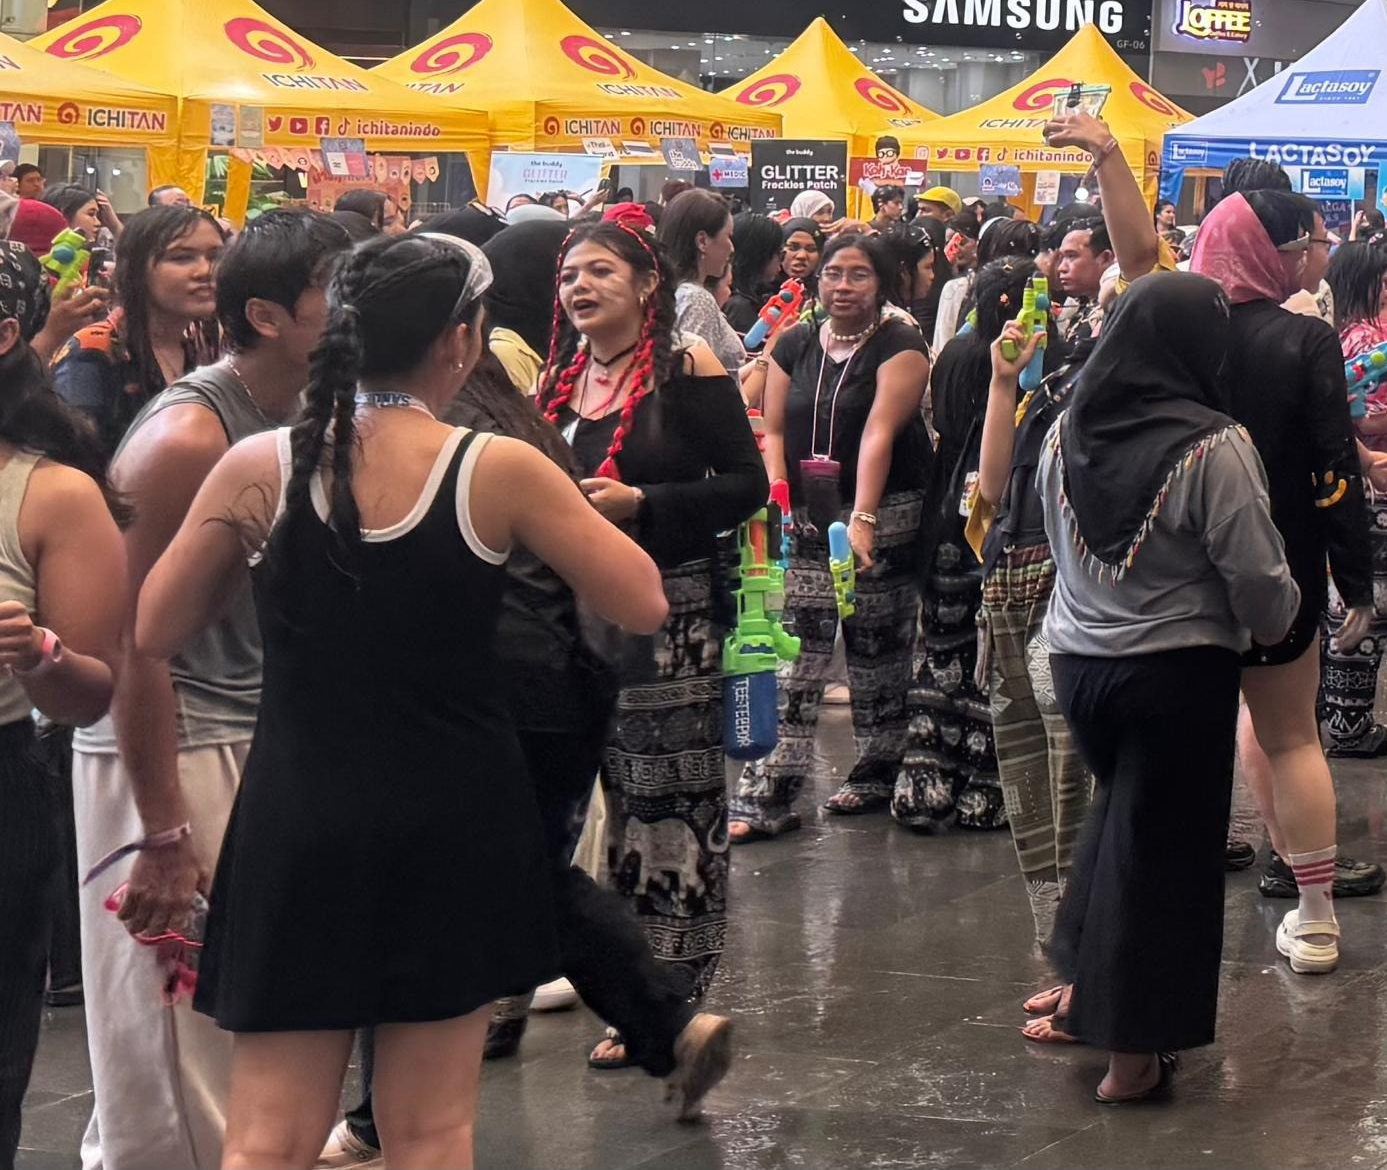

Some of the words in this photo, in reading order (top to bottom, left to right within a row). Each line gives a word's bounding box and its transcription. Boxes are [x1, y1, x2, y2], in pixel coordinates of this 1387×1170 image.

[1116, 39, 1146, 50] GF-06
[262, 73, 369, 92] ICHITAN
[1281, 75, 1372, 101] Lactasoy
[595, 83, 683, 99] ICHITAN
[87, 108, 166, 131] ICHITAN
[357, 118, 441, 137] ichitanindo
[564, 119, 621, 135] ICHITAN
[650, 120, 701, 137] ICHITAN
[728, 126, 776, 139] ICHITAN
[669, 149, 682, 159] the
[795, 149, 814, 157] buddy
[1014, 150, 1093, 163] ichitanindo
[1250, 141, 1376, 167] LACTASOY
[761, 165, 839, 180] GLITTER
[761, 180, 805, 190] Freckles
[806, 180, 838, 190] Patch
[1301, 170, 1347, 194] Lactasoy
